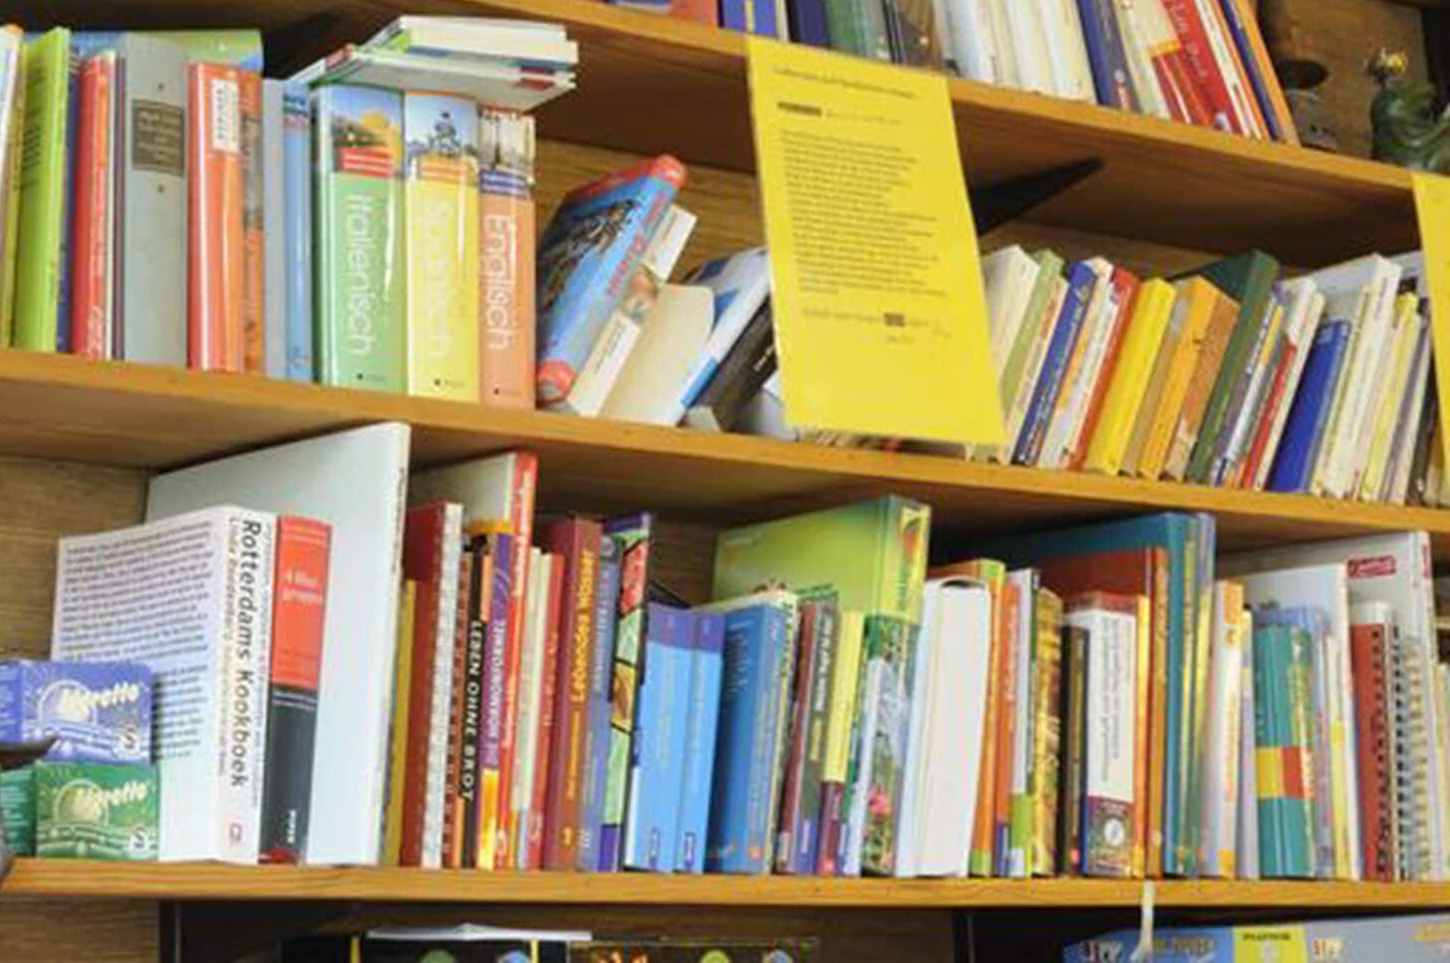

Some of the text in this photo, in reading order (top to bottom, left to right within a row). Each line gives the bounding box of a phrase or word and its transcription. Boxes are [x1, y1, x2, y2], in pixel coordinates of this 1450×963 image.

[344, 192, 372, 355] Italienisch
[484, 213, 514, 351] Englisch
[229, 518, 263, 788] Rotterdams Kookboek
[460, 620, 483, 801] LEBEN OHNE BROT
